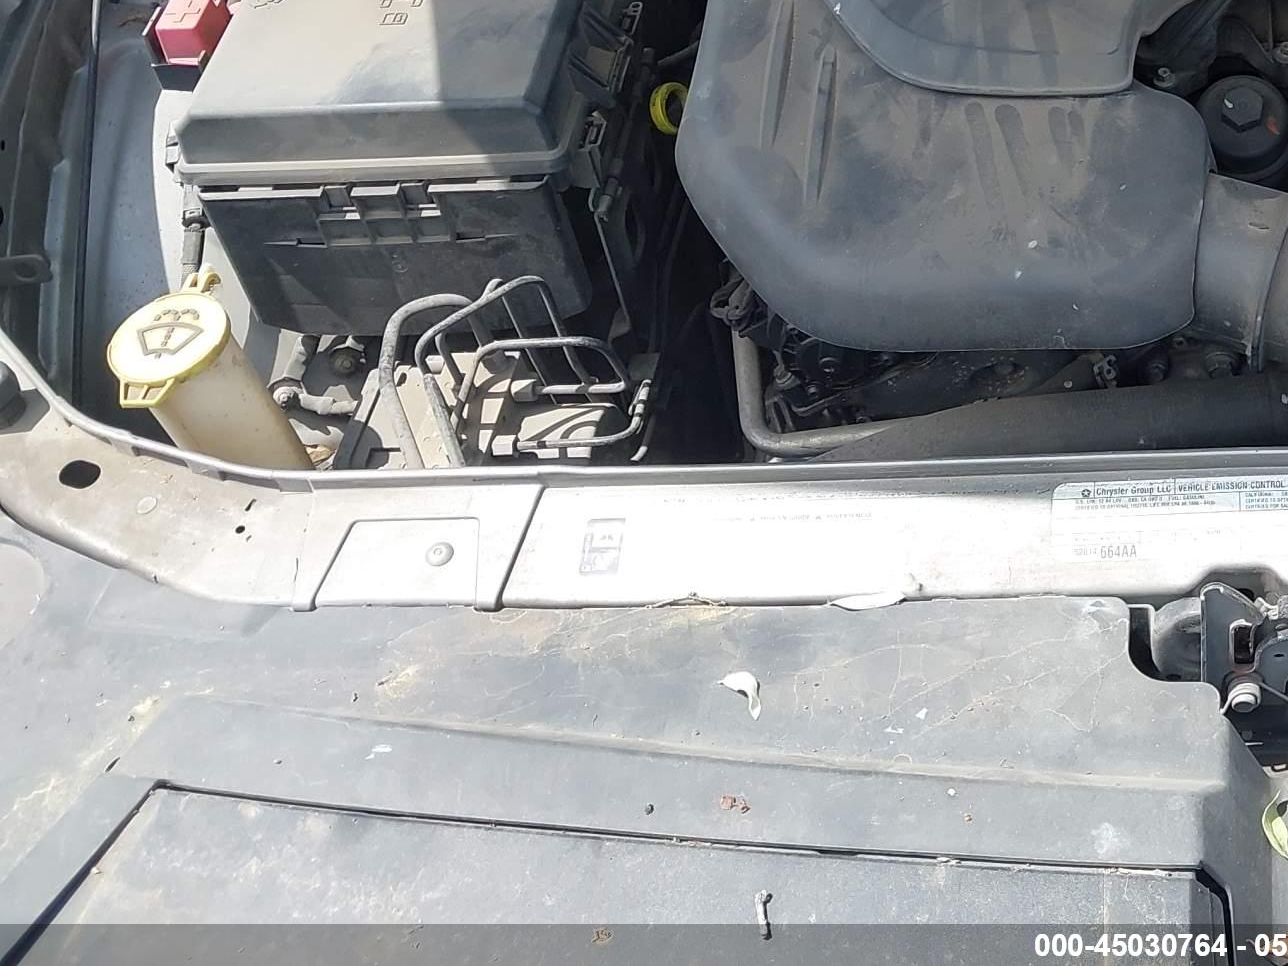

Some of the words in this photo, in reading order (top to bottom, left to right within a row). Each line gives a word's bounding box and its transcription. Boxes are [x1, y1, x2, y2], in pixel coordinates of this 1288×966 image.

[1096, 485, 1129, 497] Chrysler
[1131, 484, 1155, 496] Group
[1157, 484, 1172, 494] LLC
[1178, 482, 1210, 493] VEHICLE
[1212, 480, 1249, 491] EMISSION
[1250, 479, 1287, 490] CONTROL
[1100, 545, 1137, 559] 664AA
